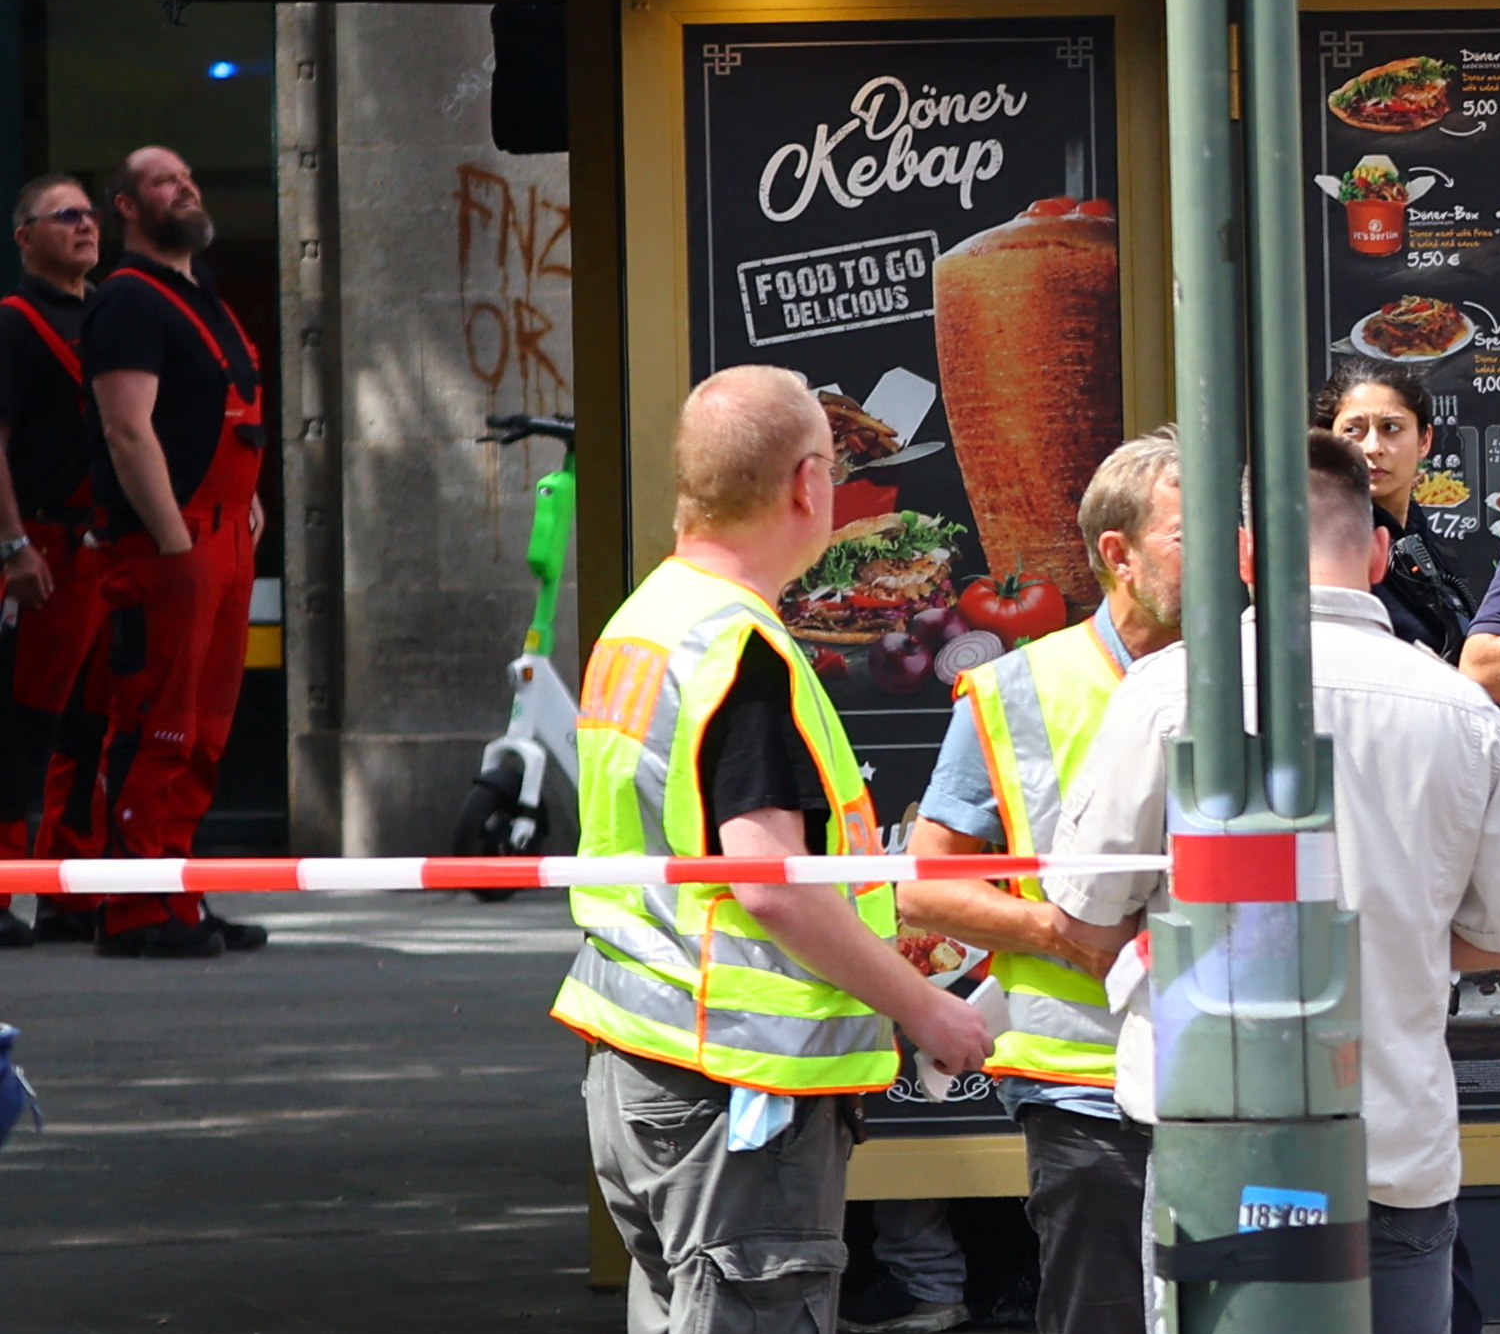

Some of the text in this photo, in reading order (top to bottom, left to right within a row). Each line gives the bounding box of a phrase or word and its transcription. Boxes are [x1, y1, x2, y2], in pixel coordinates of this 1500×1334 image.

[850, 75, 1028, 141] Döner
[1462, 99, 1498, 118] 5,00
[758, 123, 1004, 223] Kebap
[755, 248, 927, 306] FOOD TO GO
[1406, 250, 1461, 270] 5,50 €
[782, 285, 910, 329] DELICIOUS
